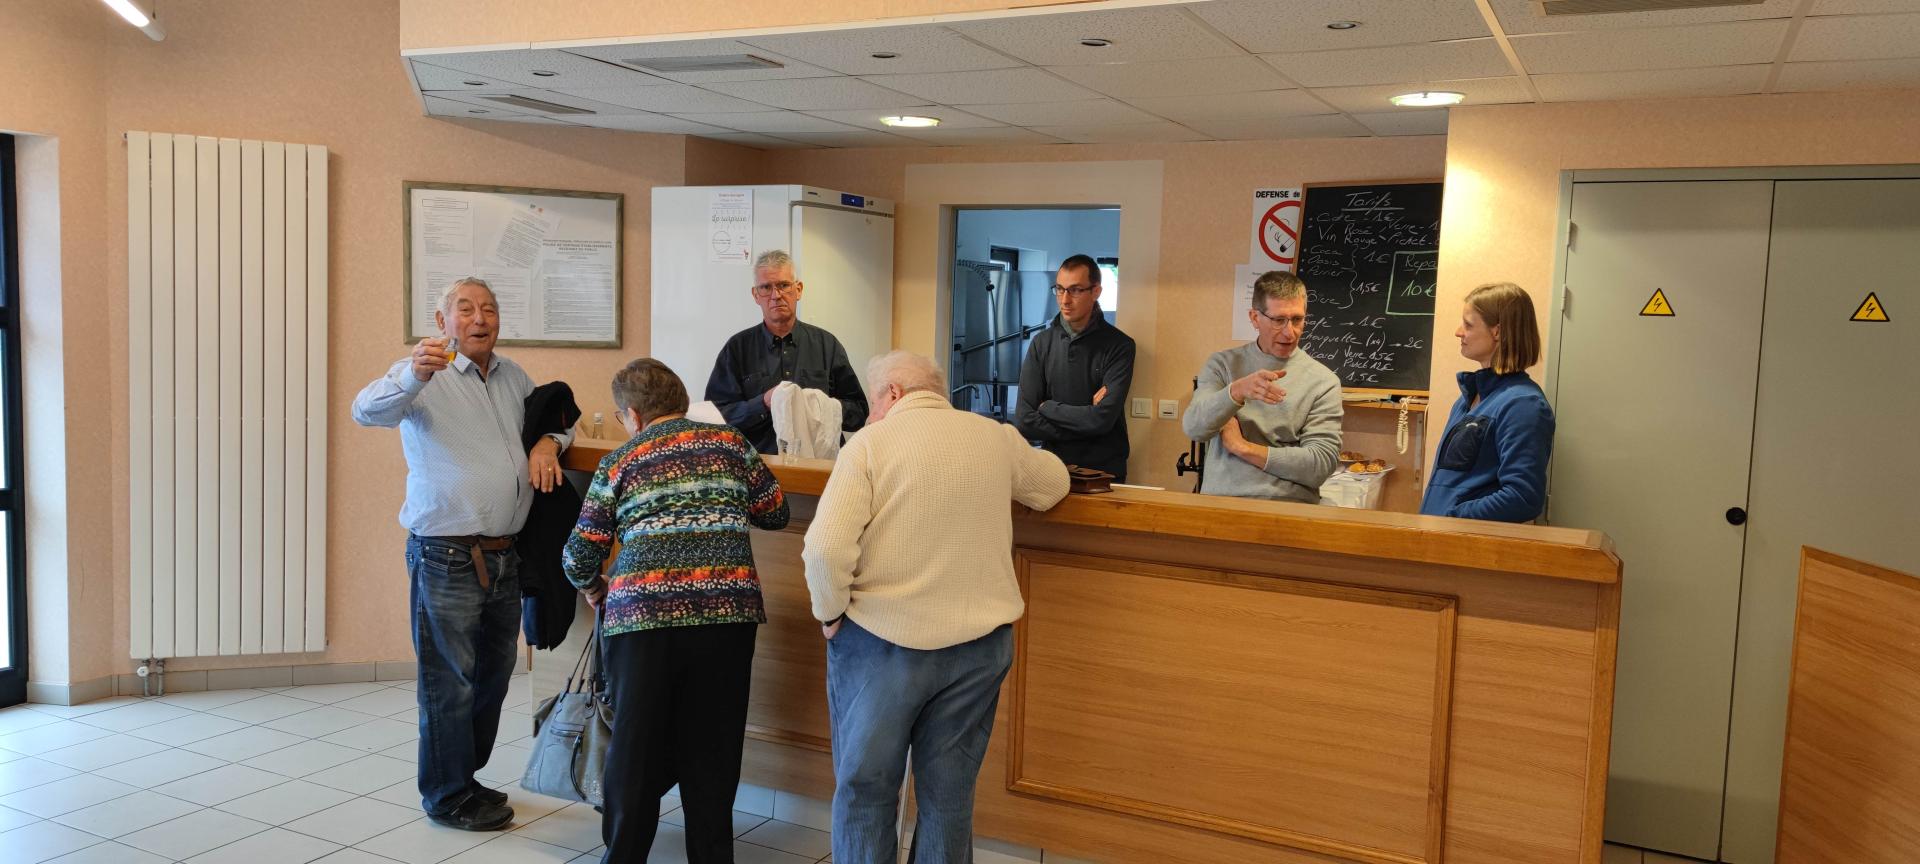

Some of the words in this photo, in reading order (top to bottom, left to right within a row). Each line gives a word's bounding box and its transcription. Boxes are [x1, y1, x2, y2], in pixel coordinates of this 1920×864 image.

[1255, 190, 1289, 198] DEFENSE
[1345, 191, 1391, 215] Tarifs
[1319, 224, 1337, 243] Vin
[1344, 234, 1377, 250] Rouge
